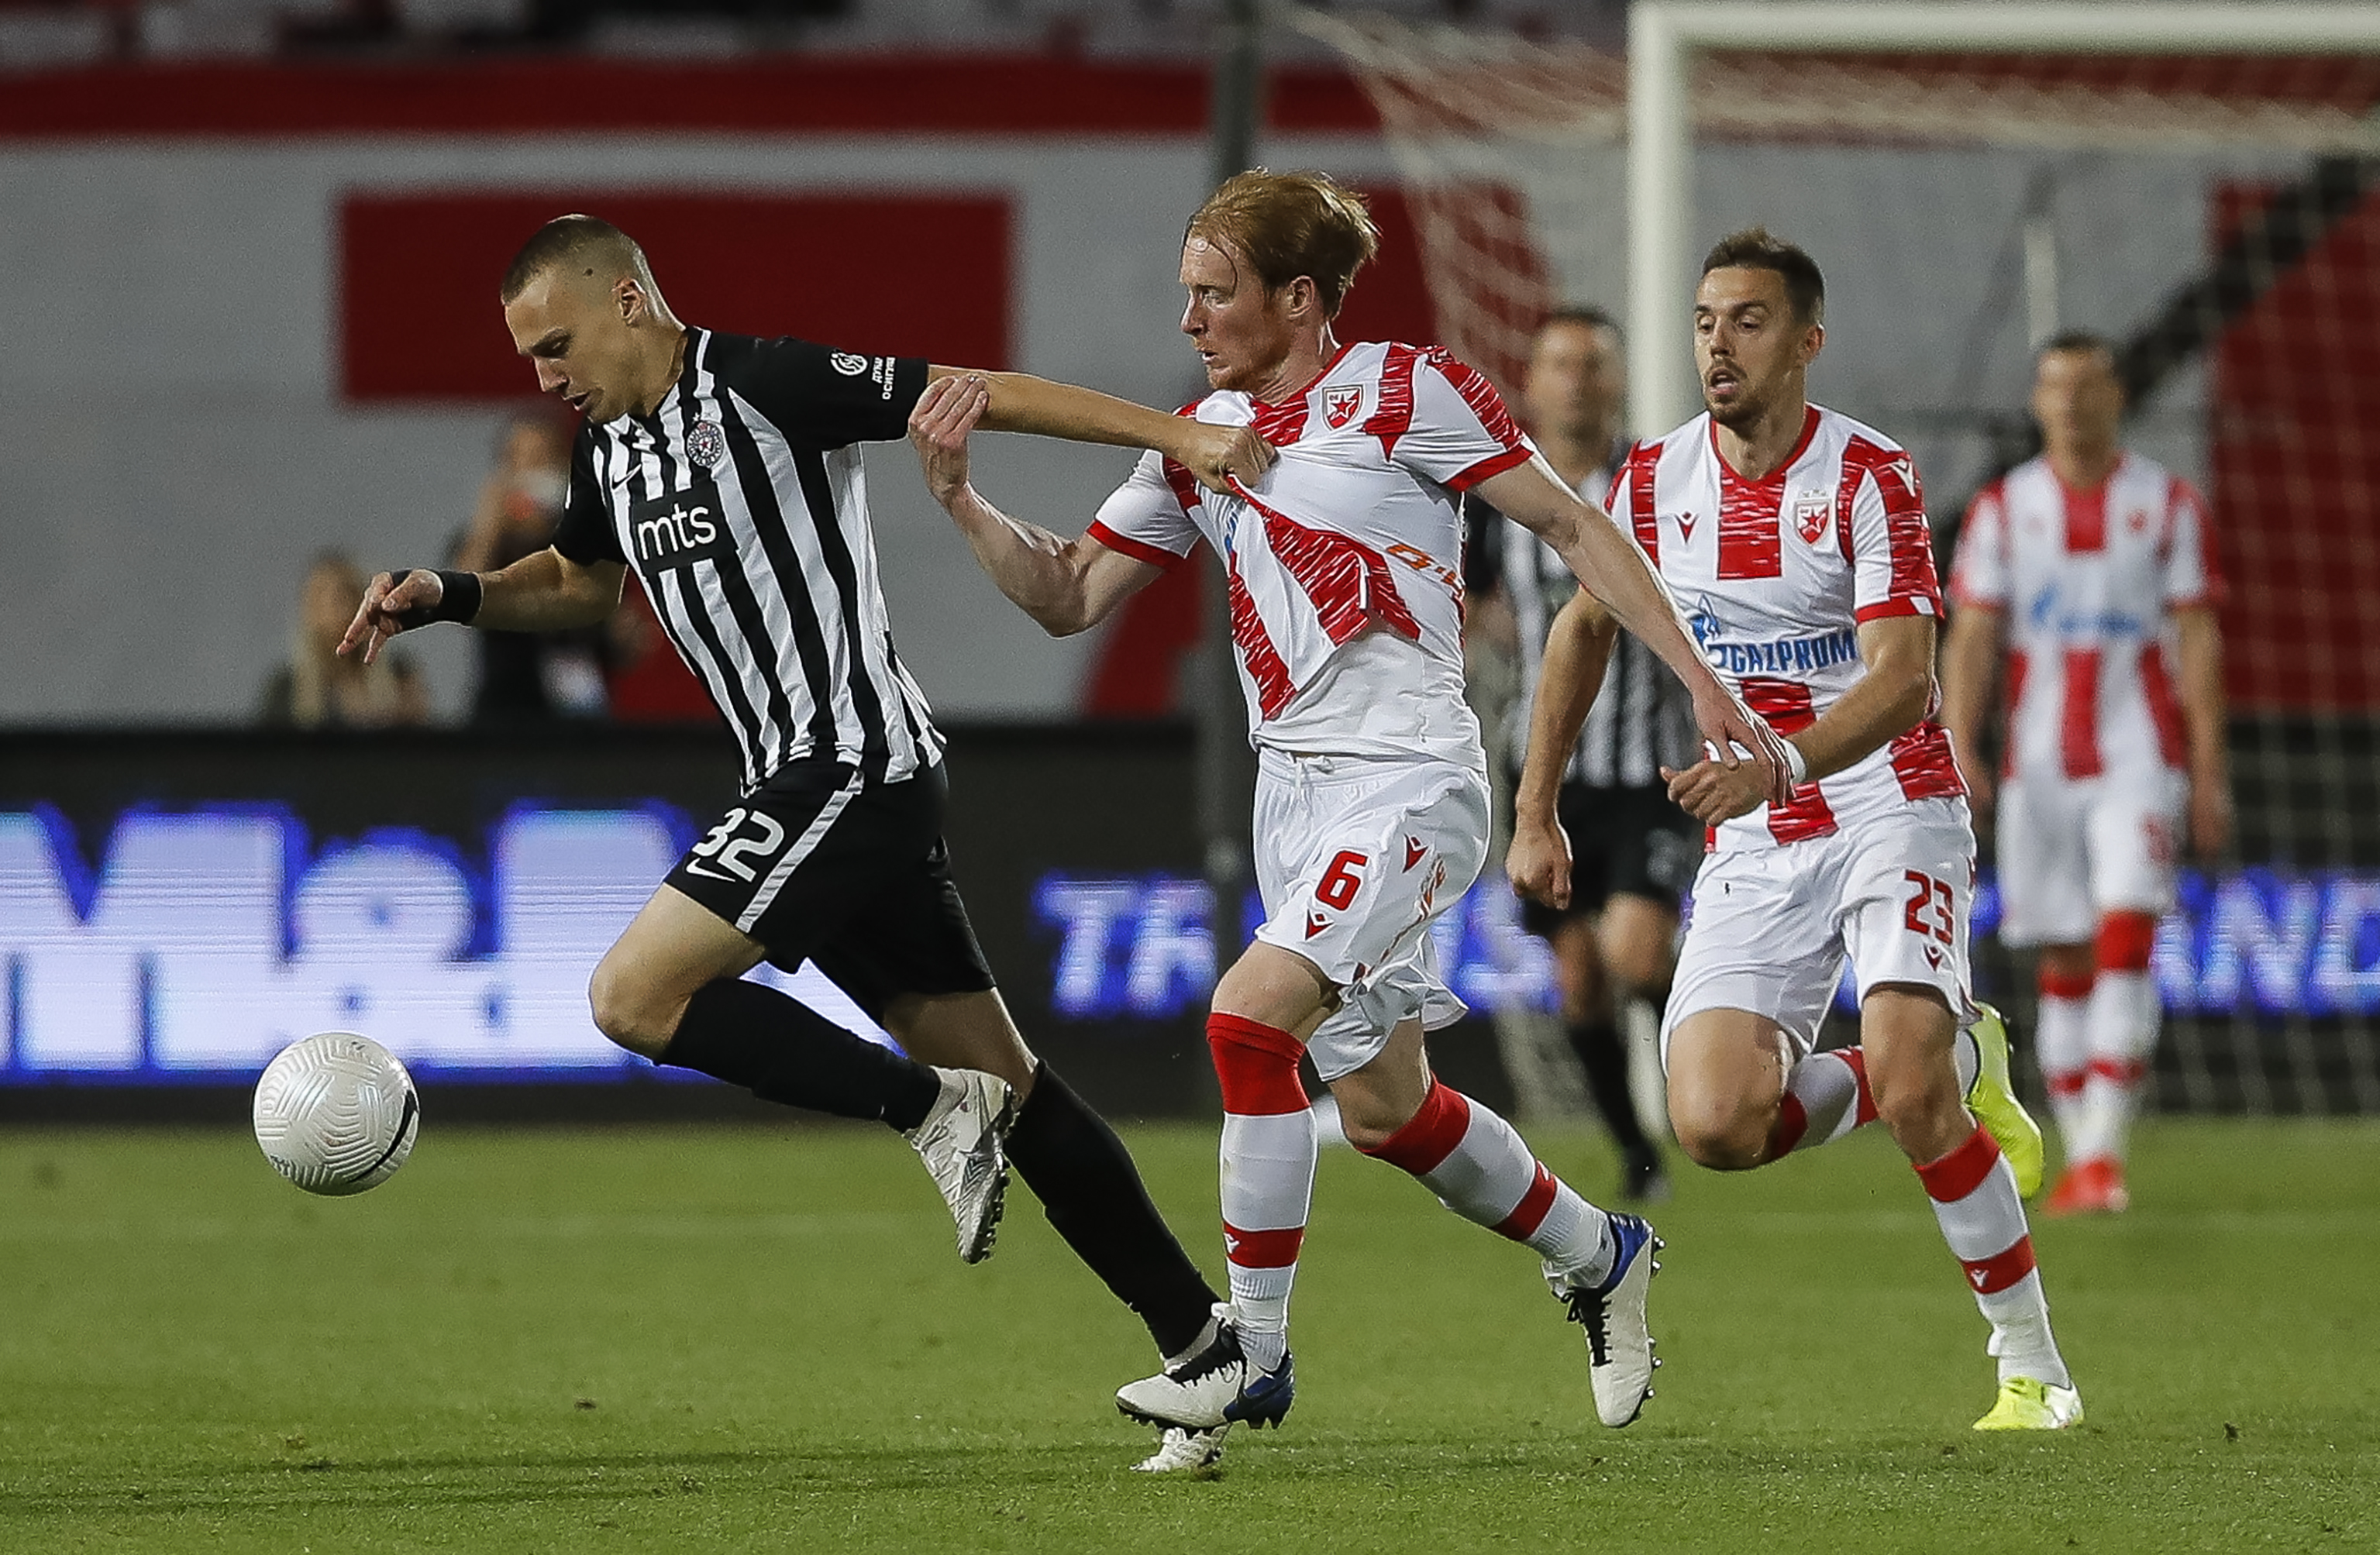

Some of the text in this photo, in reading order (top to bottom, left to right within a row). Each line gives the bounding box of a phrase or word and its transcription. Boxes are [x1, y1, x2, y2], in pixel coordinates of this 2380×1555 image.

[637, 503, 717, 561] mts
[1731, 628, 1858, 673] GAZPROM
[691, 807, 785, 883] 32
[1315, 849, 1369, 912] 6
[1904, 869, 1955, 947] 23
